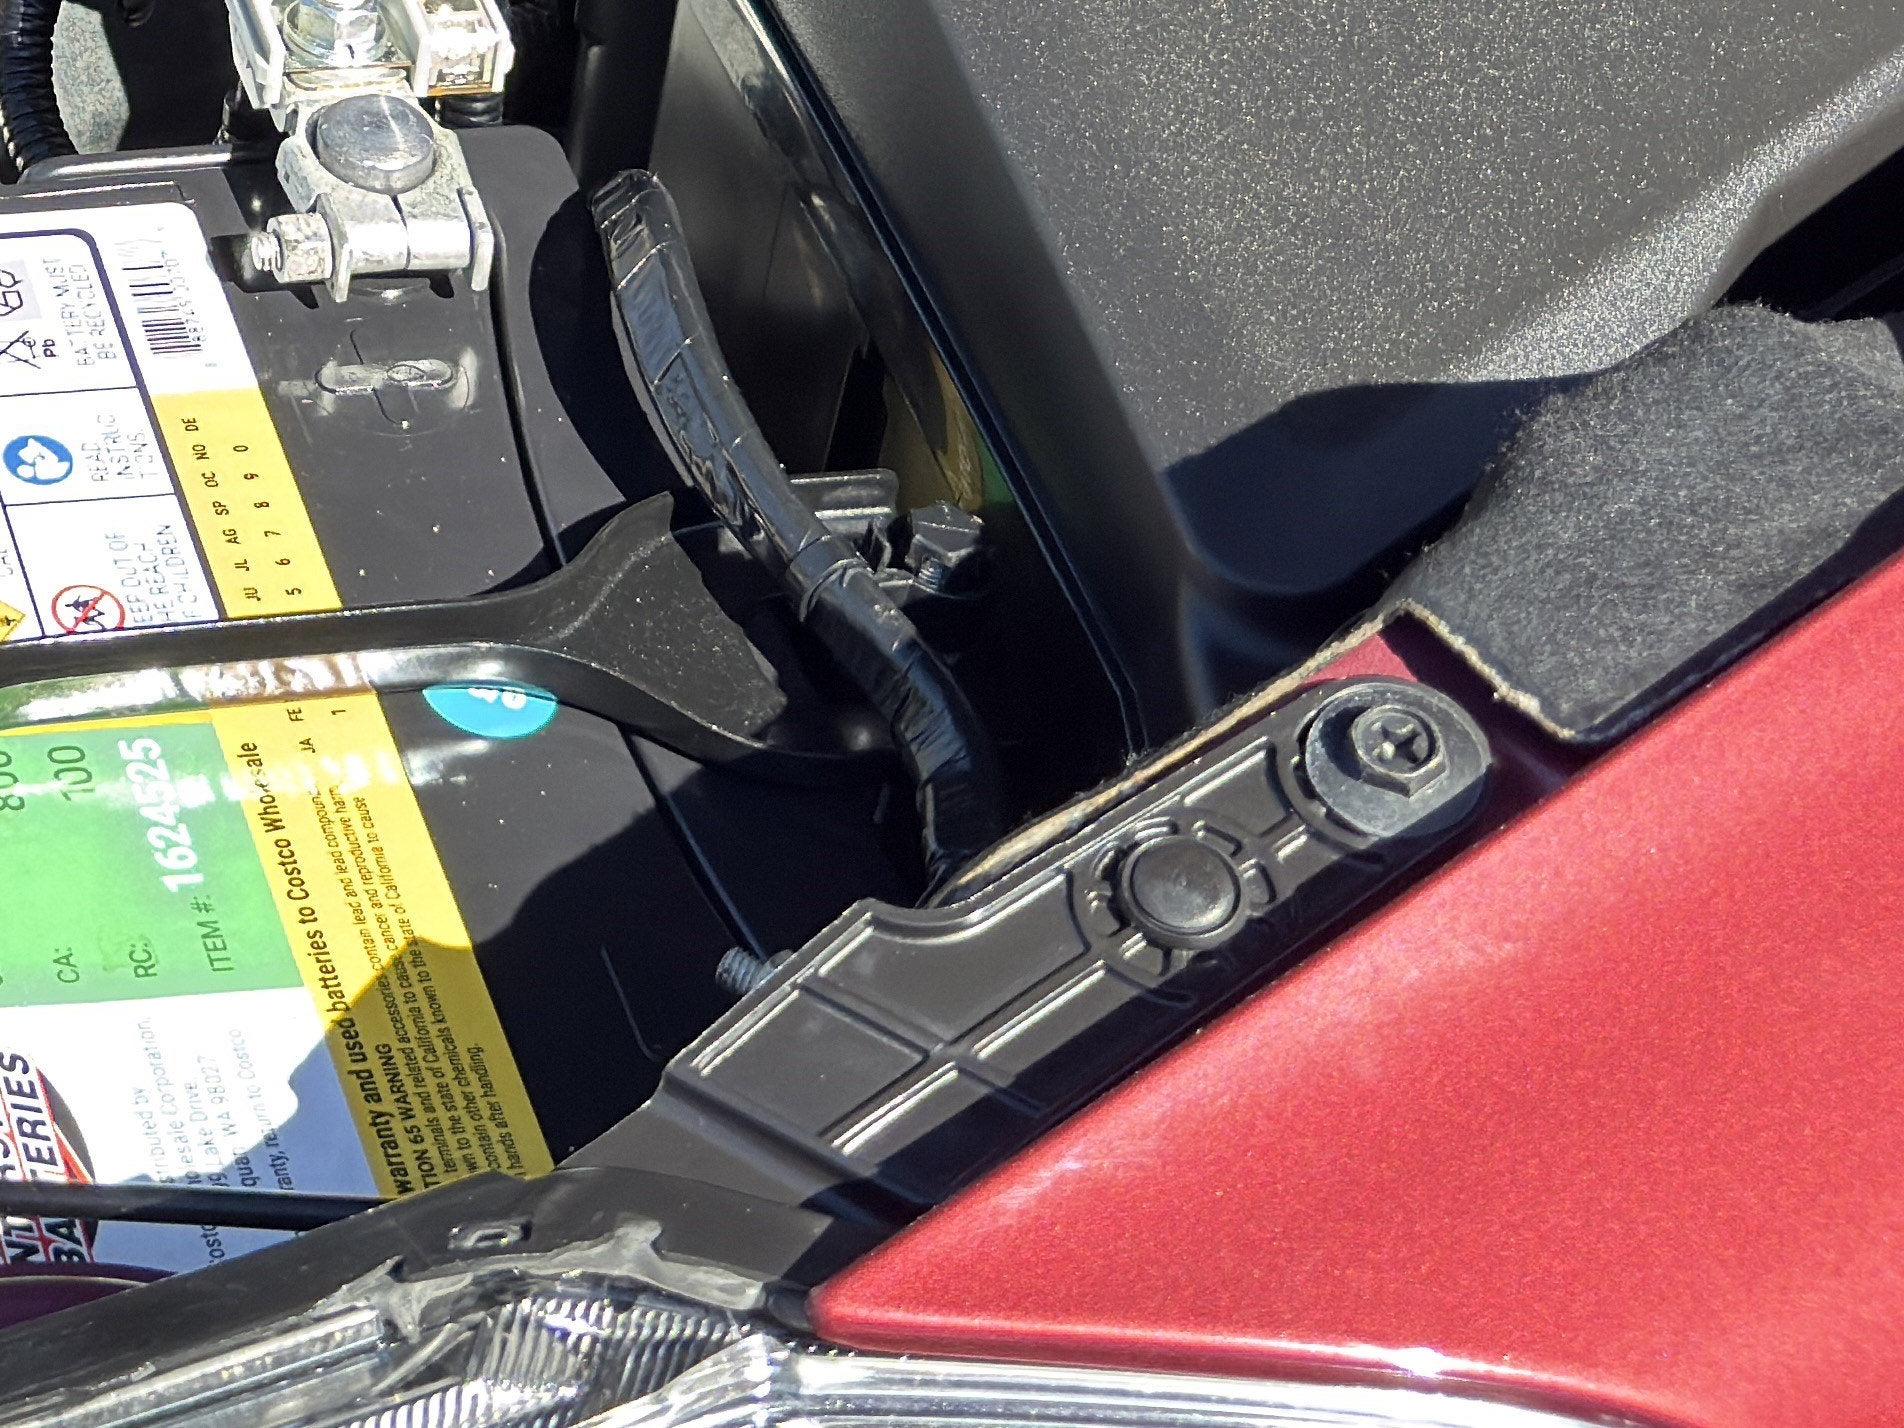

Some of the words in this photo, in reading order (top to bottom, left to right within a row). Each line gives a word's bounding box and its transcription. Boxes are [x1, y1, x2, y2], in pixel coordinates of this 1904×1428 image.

[38, 338, 59, 358] Pb
[179, 416, 199, 432] DE
[189, 443, 210, 460] NO
[230, 444, 249, 453] 0
[199, 470, 220, 488] OC
[241, 471, 259, 481] 9
[210, 499, 230, 516] SP
[252, 500, 270, 509] 8
[220, 527, 241, 546] AG
[262, 528, 281, 537] 7
[231, 558, 251, 572] JL
[273, 557, 292, 566] 6
[241, 585, 262, 602] JU
[284, 586, 303, 596] 5
[284, 707, 305, 721] FE
[296, 737, 316, 753] JA
[119, 738, 205, 892] 1624525
[351, 796, 375, 829] cause
[335, 816, 377, 884] reproductive
[266, 838, 311, 900] Costco
[367, 846, 402, 899] California
[336, 877, 358, 897] and
[362, 888, 383, 908] and
[185, 894, 216, 913] #:
[292, 906, 320, 923] to
[344, 902, 368, 924] lead
[372, 913, 398, 950] cancer
[193, 919, 237, 973] ITEM
[405, 948, 426, 966] the
[47, 946, 83, 983] CA:
[123, 942, 160, 978] RC:
[297, 929, 351, 1011] batteries
[414, 970, 432, 982] to
[398, 991, 418, 1002] to
[418, 985, 447, 1024] known
[328, 1017, 369, 1063] used
[403, 1006, 441, 1062] California
[396, 1047, 427, 1087] related
[433, 1027, 470, 1086] chemicals
[373, 1042, 417, 1119] WARNING
[424, 1067, 445, 1078] of
[460, 1042, 500, 1097] handling.
[345, 1069, 383, 1104] and
[430, 1081, 458, 1111] state
[411, 1091, 436, 1113] and
[456, 1090, 483, 1120] other
[443, 1115, 466, 1133] the
[482, 1101, 508, 1128] after
[402, 1124, 425, 1144] 65
[422, 1117, 459, 1172] terminals
[452, 1136, 472, 1150] to
[194, 1128, 224, 1166] Lake
[361, 1109, 422, 1195] warranty
[470, 1124, 501, 1168] contain
[494, 1132, 523, 1168] hands
